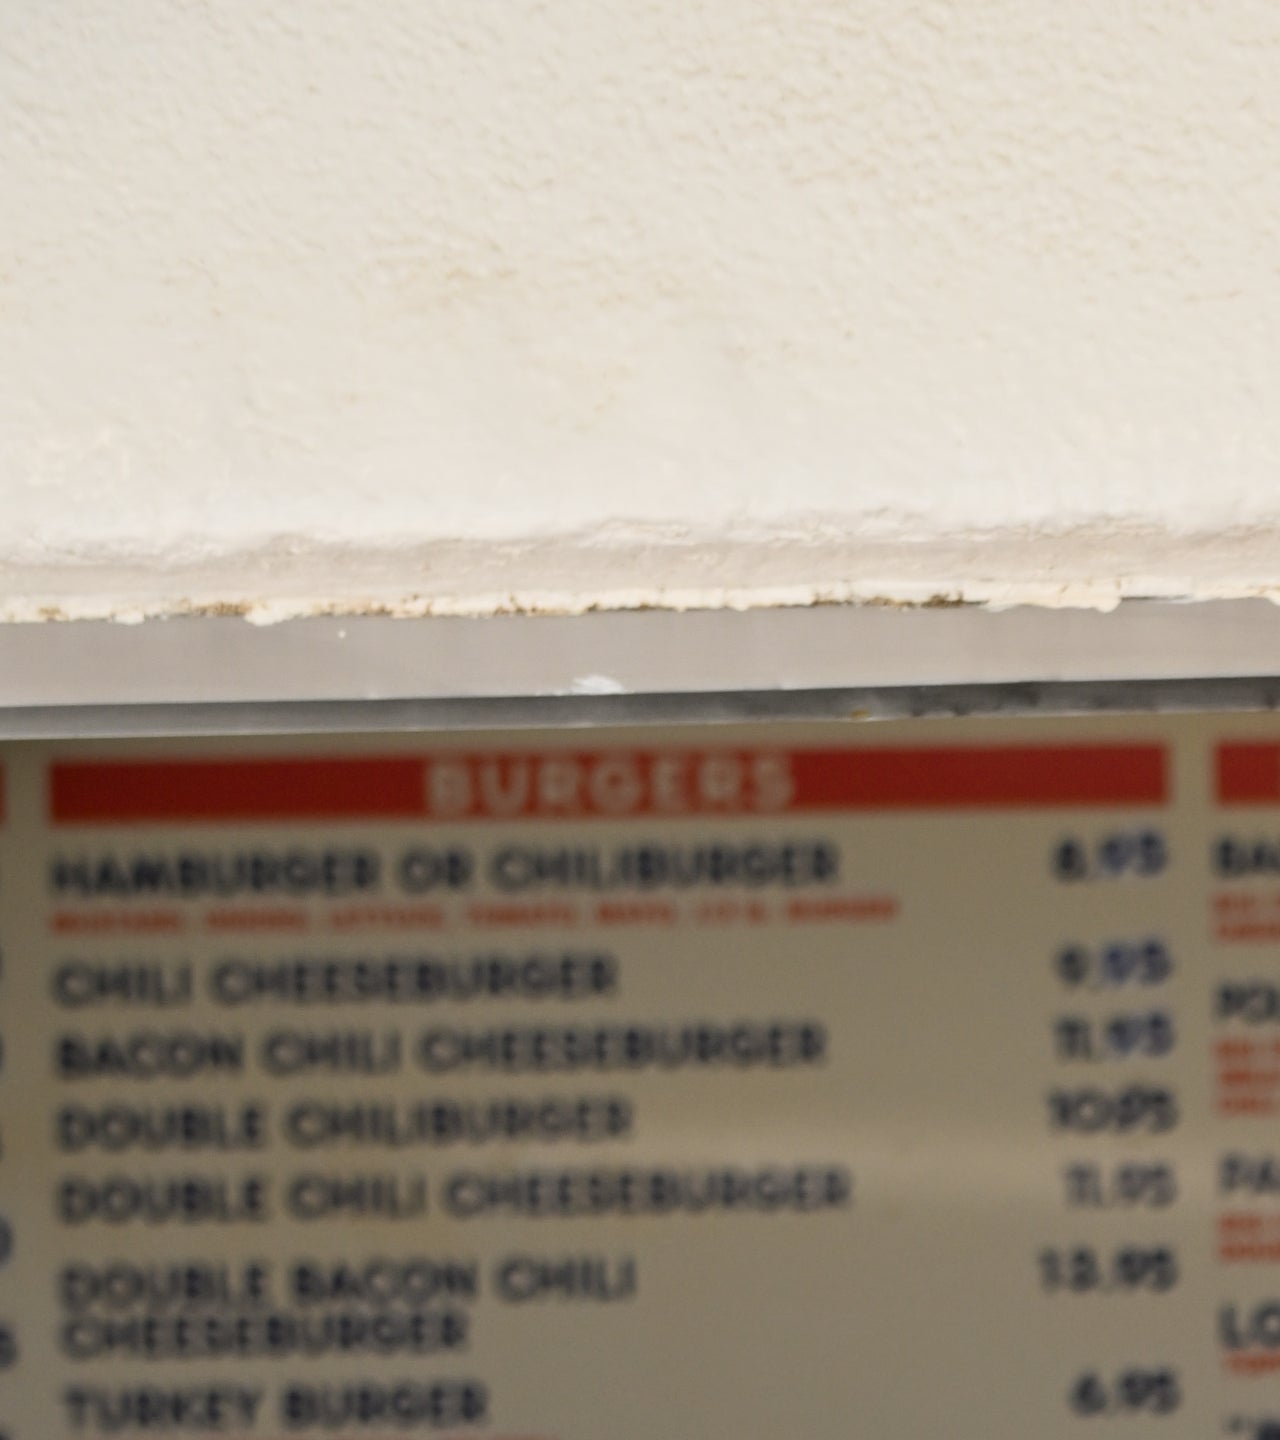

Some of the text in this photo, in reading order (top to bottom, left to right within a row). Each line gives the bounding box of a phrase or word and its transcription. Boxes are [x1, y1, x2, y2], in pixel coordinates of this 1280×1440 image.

[428, 753, 796, 818] BURGERS
[52, 842, 838, 898] HAMBURGER OR CHILIBURGER
[50, 954, 616, 1007] CHILI CHEESEBURGER
[53, 1021, 827, 1080] BACON CHILI CHEESEBURGER
[57, 1094, 633, 1153] DOUBLE CHILIBURGER
[59, 1169, 850, 1225] DOUBLE CHILI CHEESEBURGER
[59, 1257, 636, 1313] DOUBLE BACON CHILI
[59, 1307, 465, 1359] CHEESEBURGER
[63, 1382, 486, 1432] TURKEY BURGER
